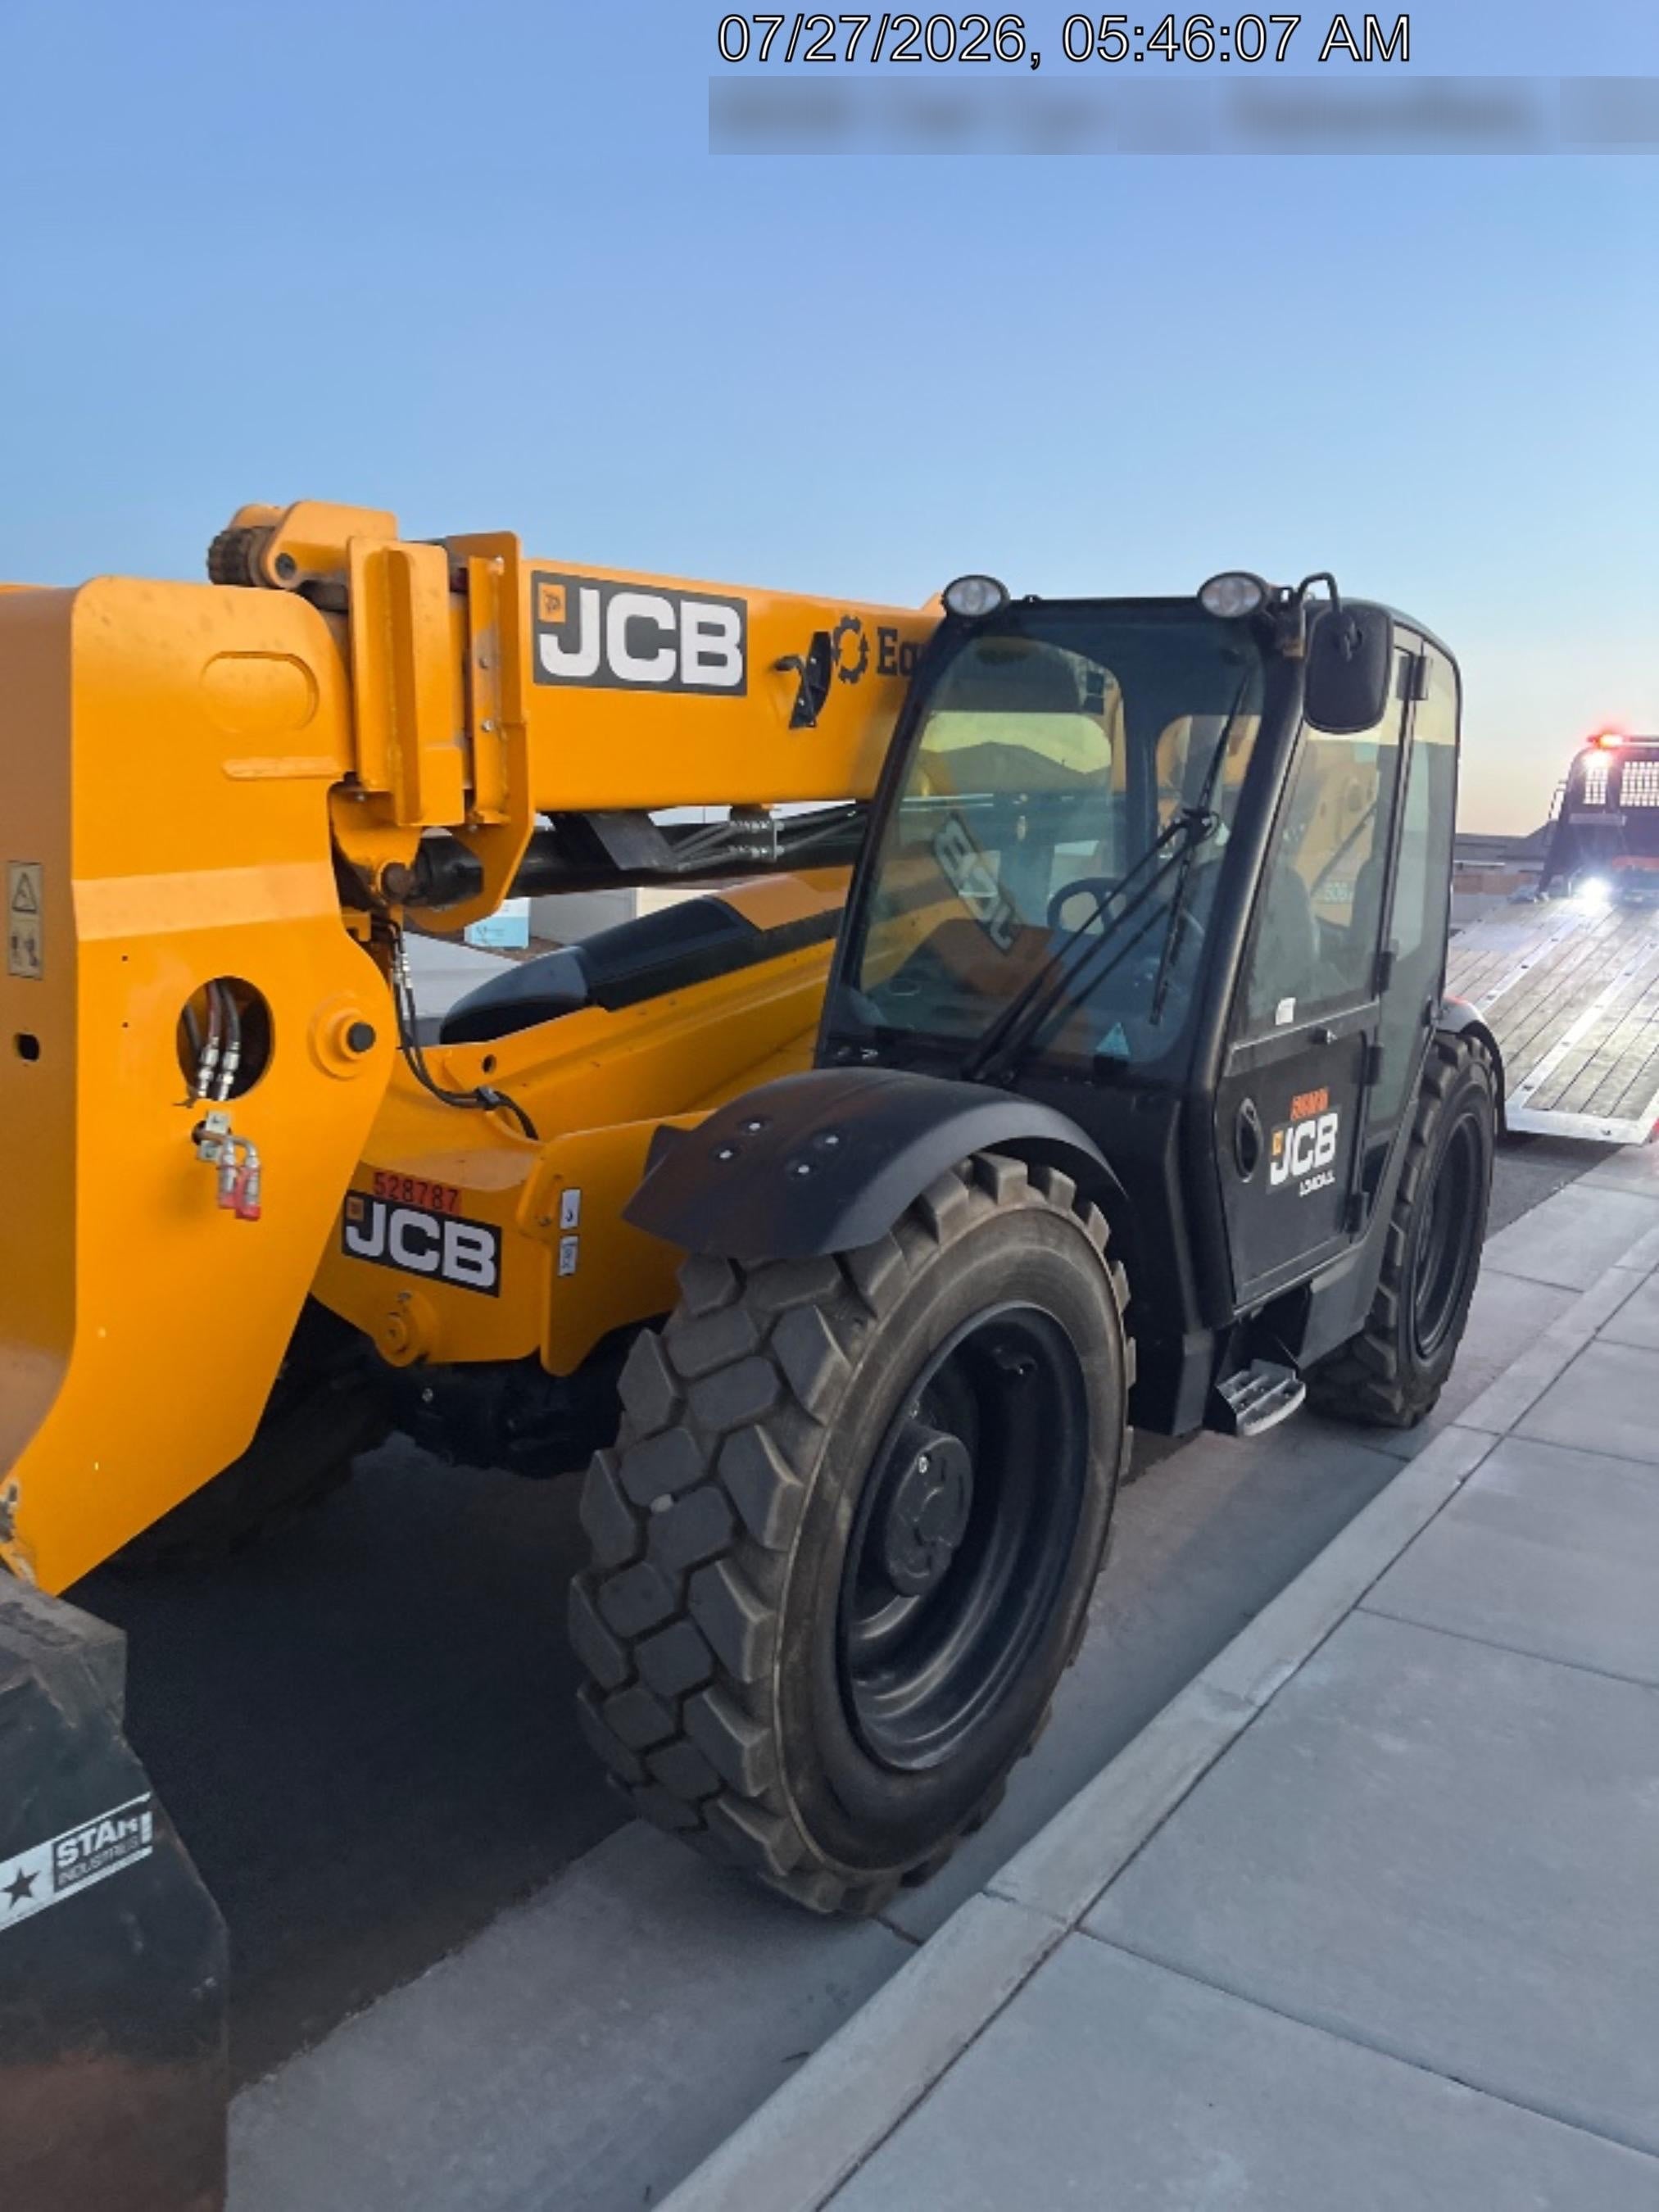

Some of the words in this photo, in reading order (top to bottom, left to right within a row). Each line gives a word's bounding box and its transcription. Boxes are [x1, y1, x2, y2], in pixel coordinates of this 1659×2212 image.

[539, 587, 743, 687] JCB
[1271, 1113, 1339, 1185] JCB
[374, 1172, 458, 1212] 528787
[346, 1201, 496, 1287] JCB
